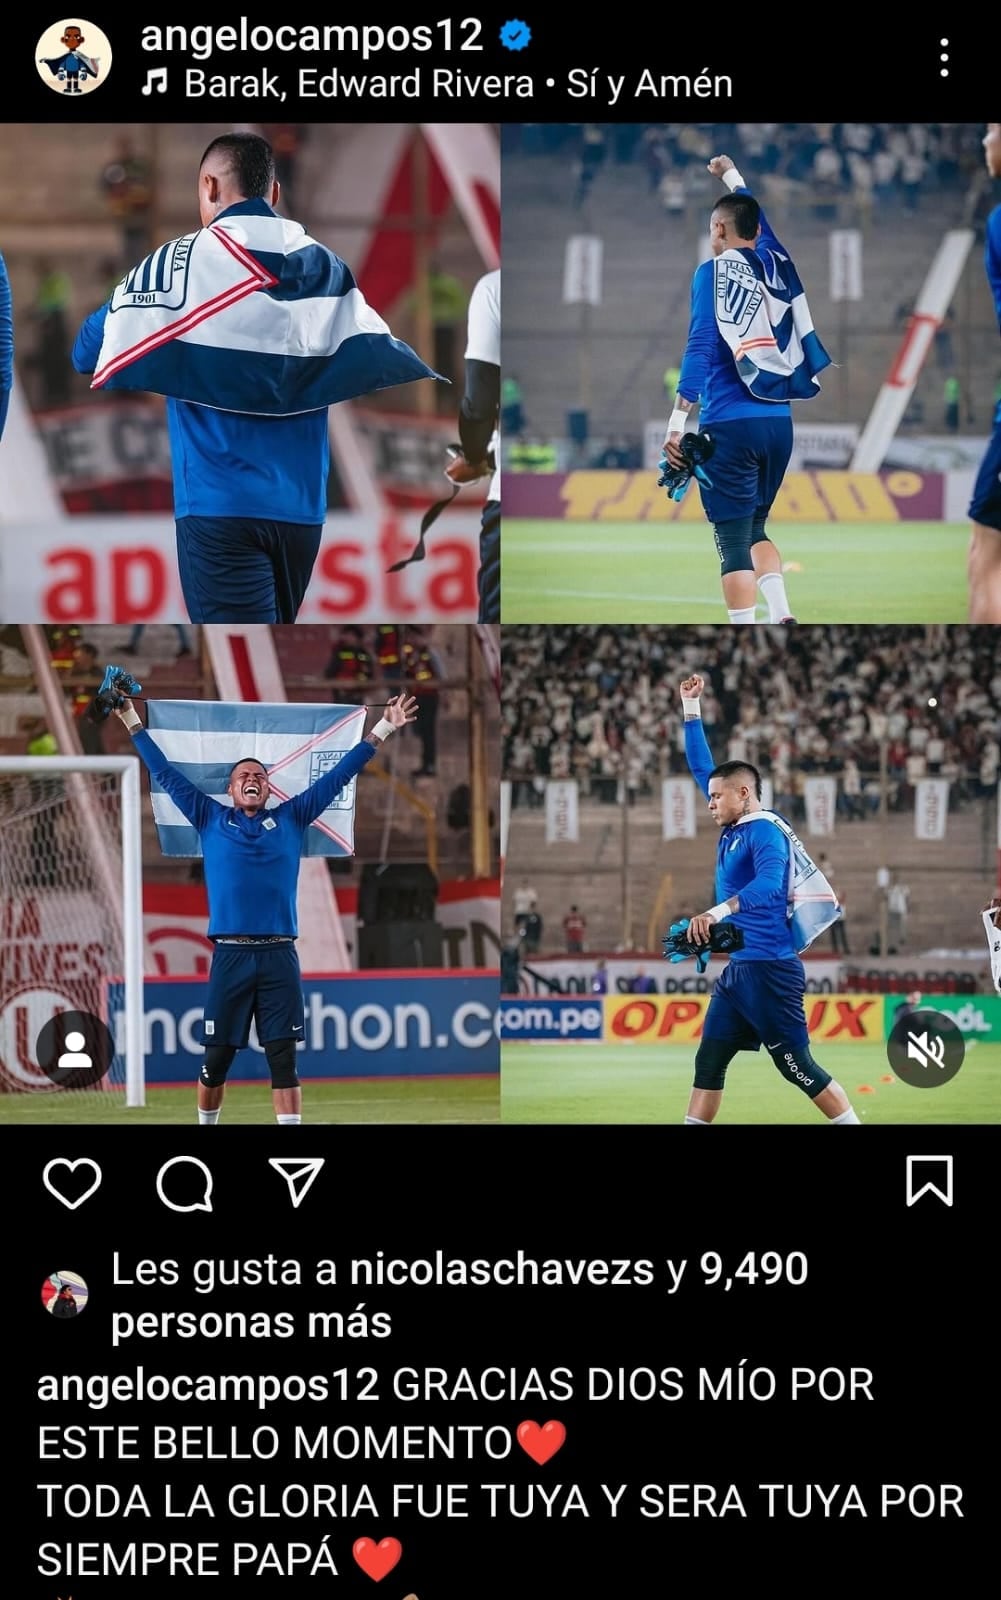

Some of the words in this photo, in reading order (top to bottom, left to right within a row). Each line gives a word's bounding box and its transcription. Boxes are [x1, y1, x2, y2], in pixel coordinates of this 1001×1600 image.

[717, 272, 726, 298] CLUB
[132, 294, 156, 304] 1901
[42, 512, 478, 623] apsta
[501, 1007, 602, 1036] om.pe
